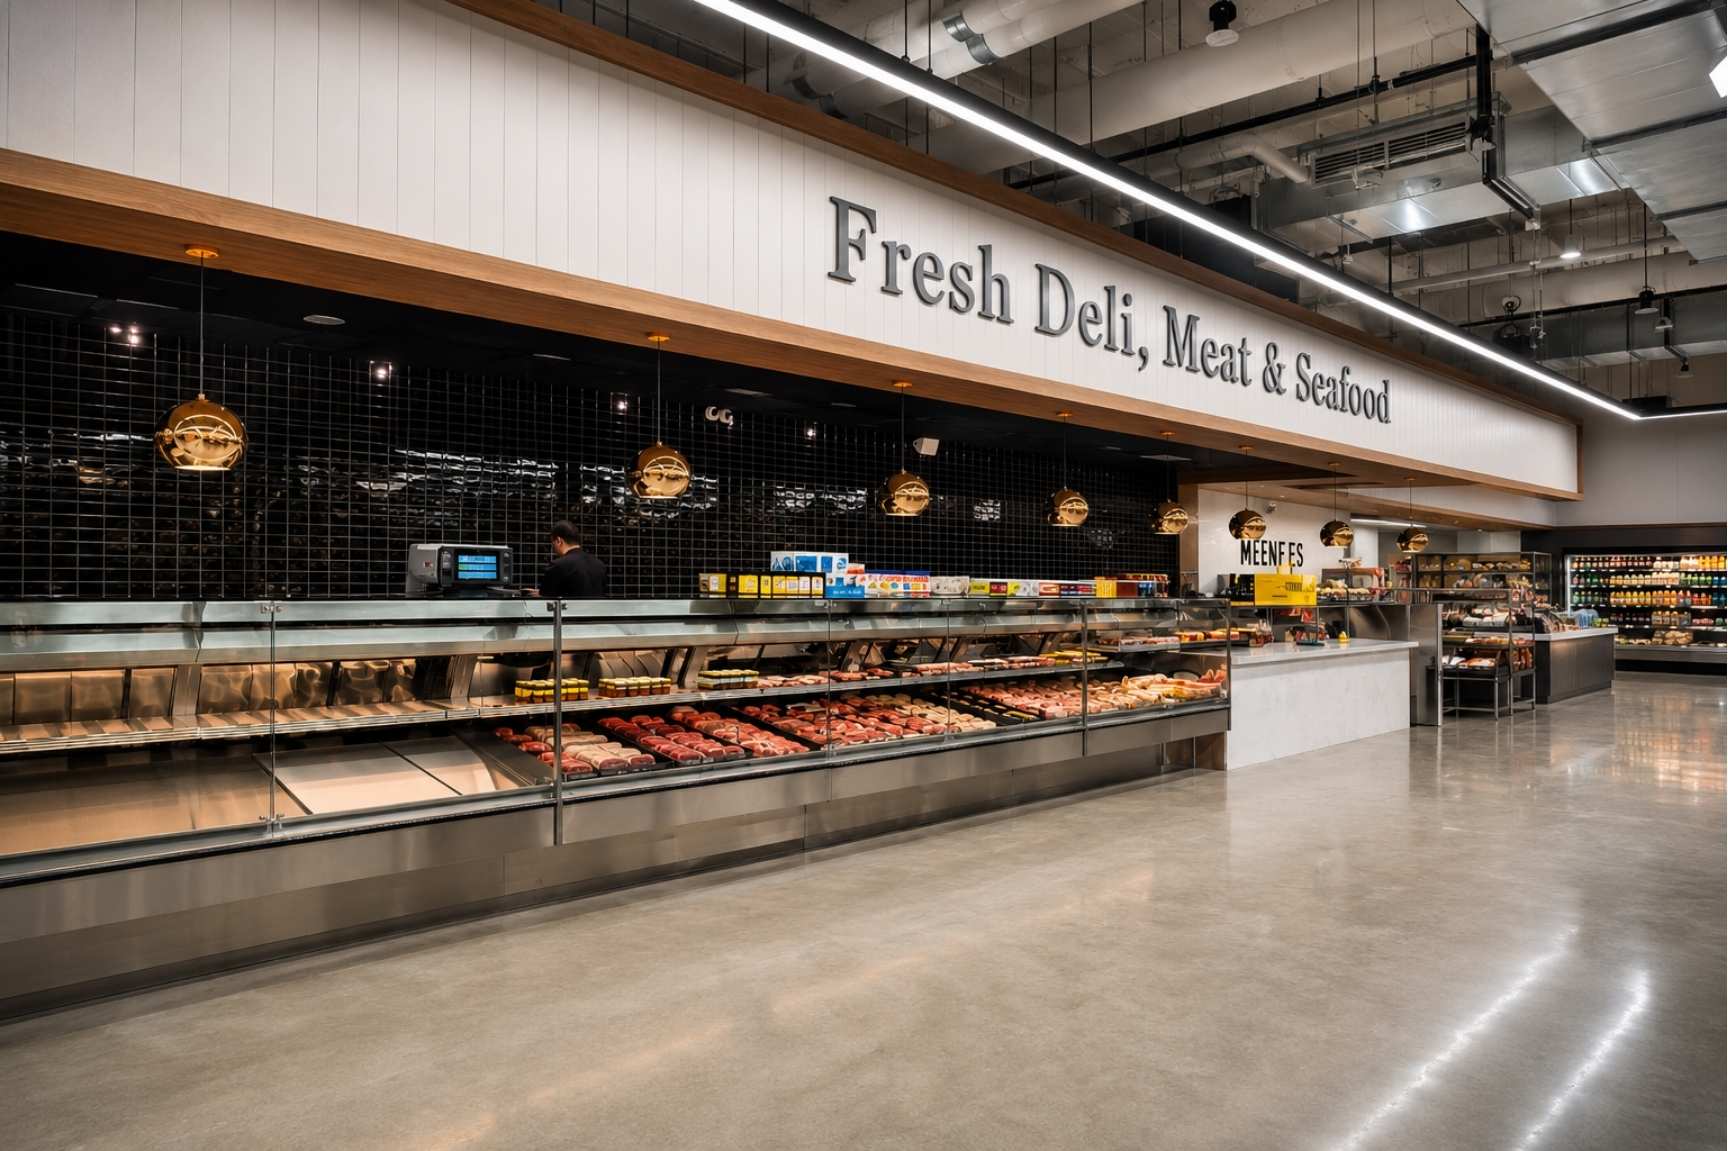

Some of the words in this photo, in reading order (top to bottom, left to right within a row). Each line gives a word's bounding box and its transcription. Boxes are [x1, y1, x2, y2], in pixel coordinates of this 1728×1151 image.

[827, 195, 1014, 325] Fresh
[1034, 262, 1150, 372] Deli,
[1162, 304, 1252, 388] Meat
[1262, 341, 1287, 396] &
[1295, 351, 1393, 425] Seafood
